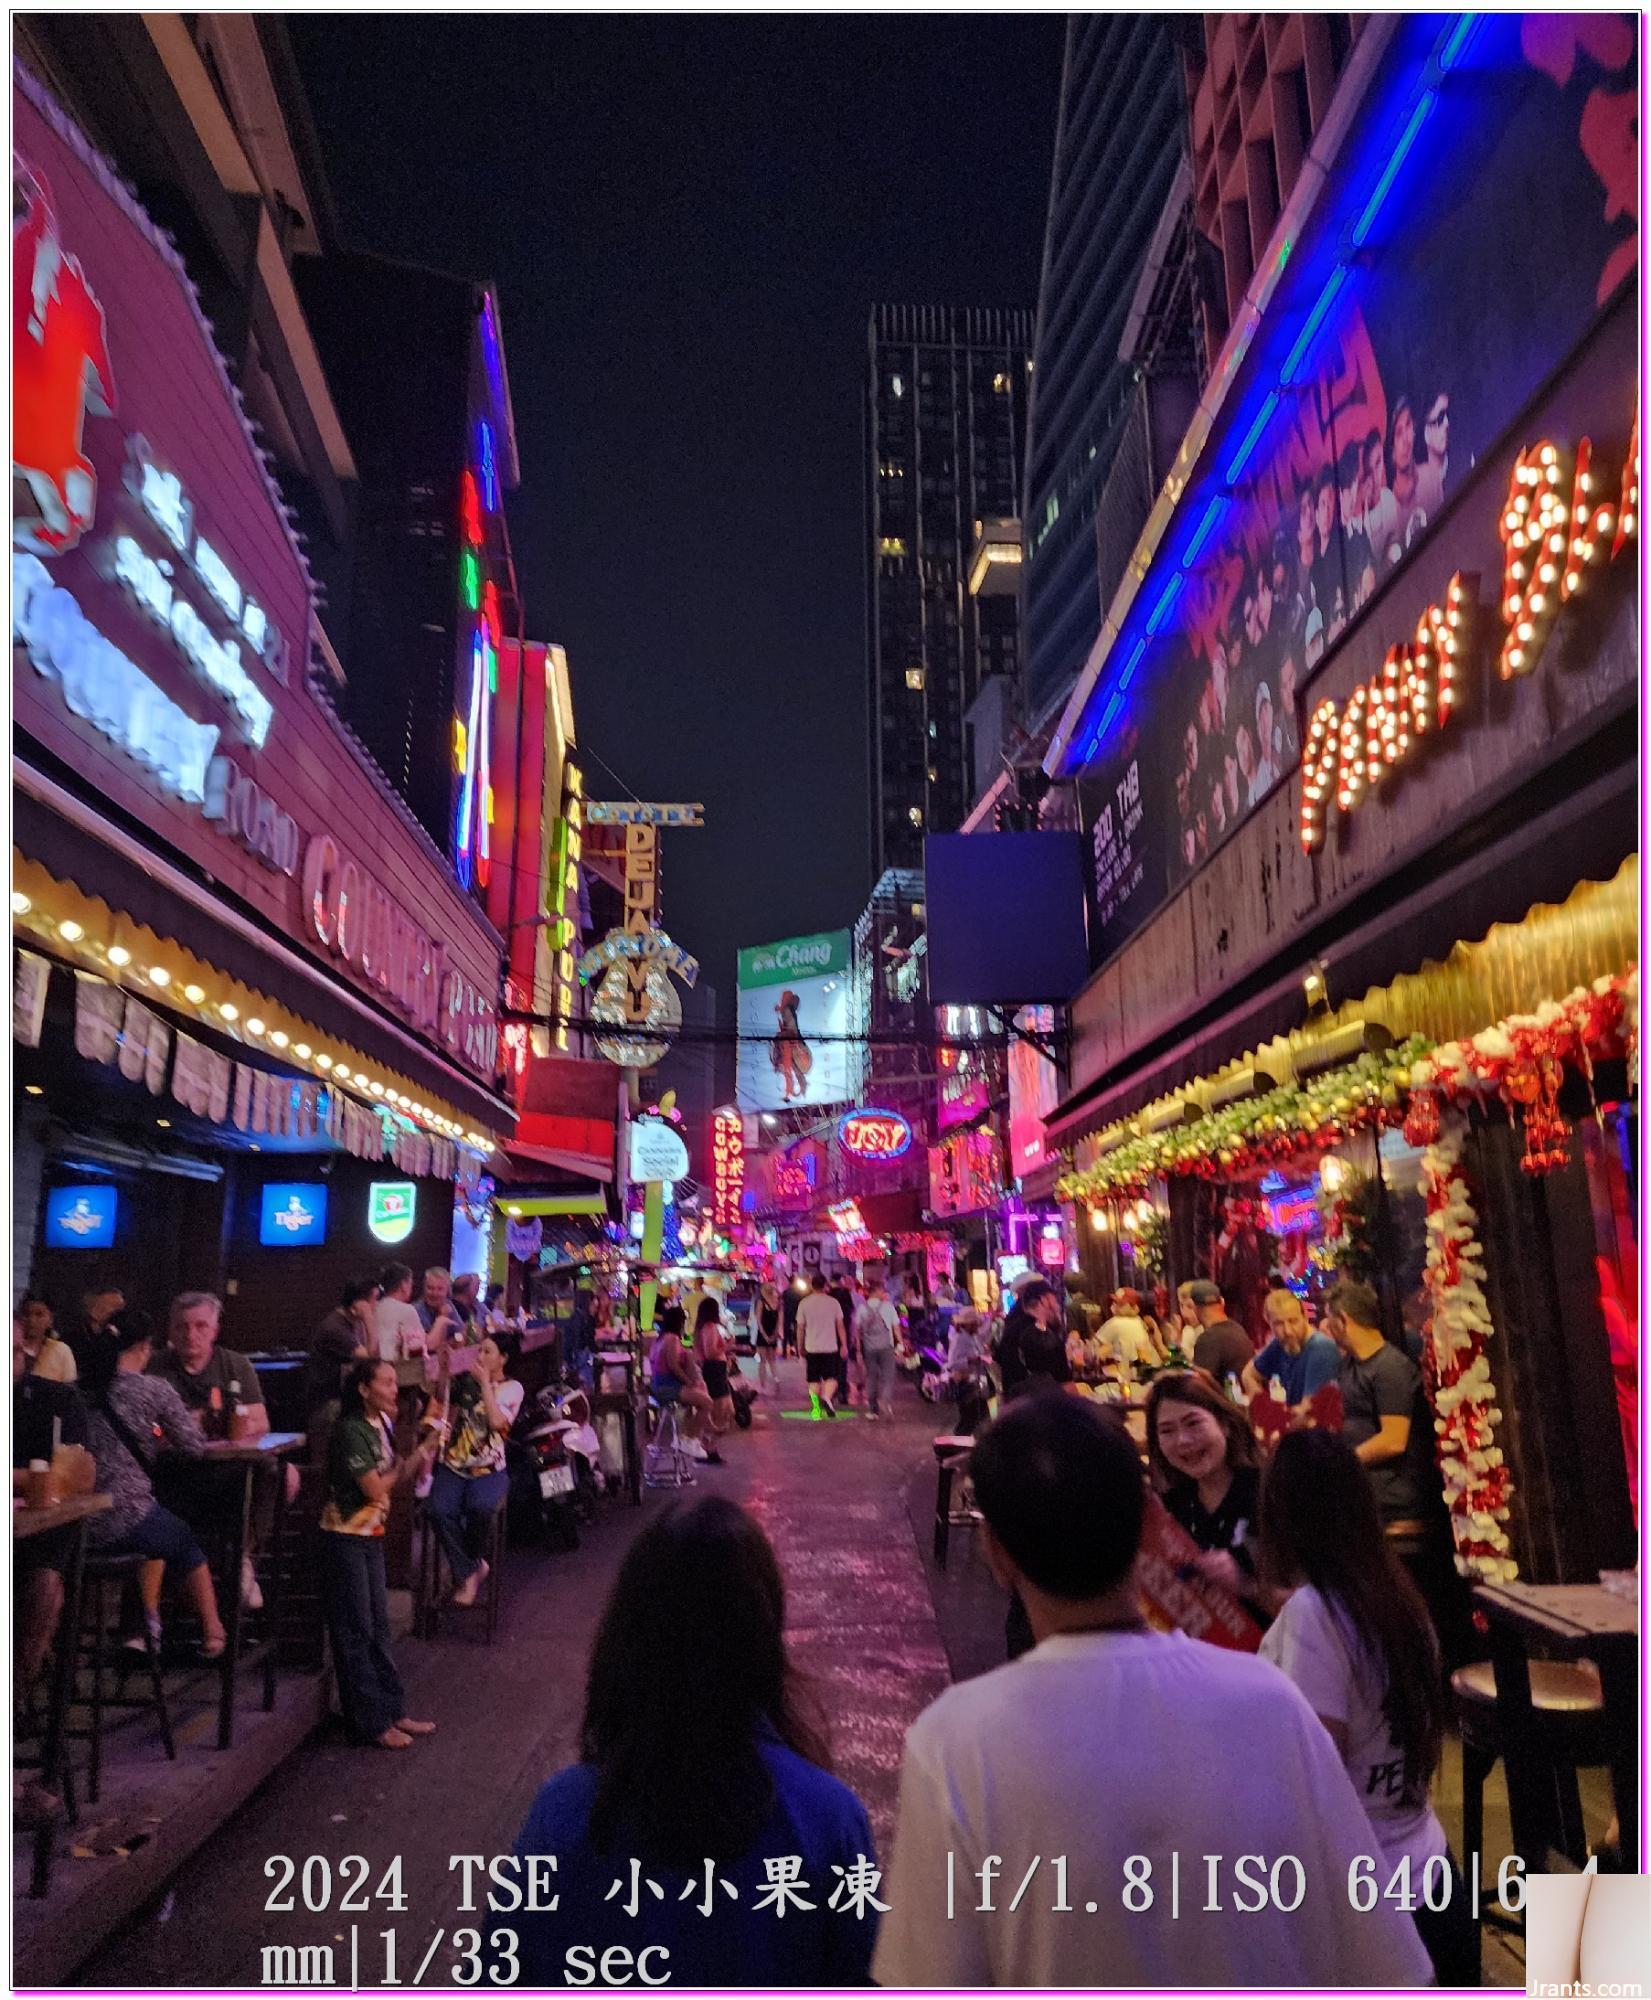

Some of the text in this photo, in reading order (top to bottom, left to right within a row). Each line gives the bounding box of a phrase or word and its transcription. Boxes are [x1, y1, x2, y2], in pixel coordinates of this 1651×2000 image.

[1301, 569, 1462, 857] PENNY
[1116, 759, 1140, 821] THB
[713, 1116, 728, 1208] COWBOY
